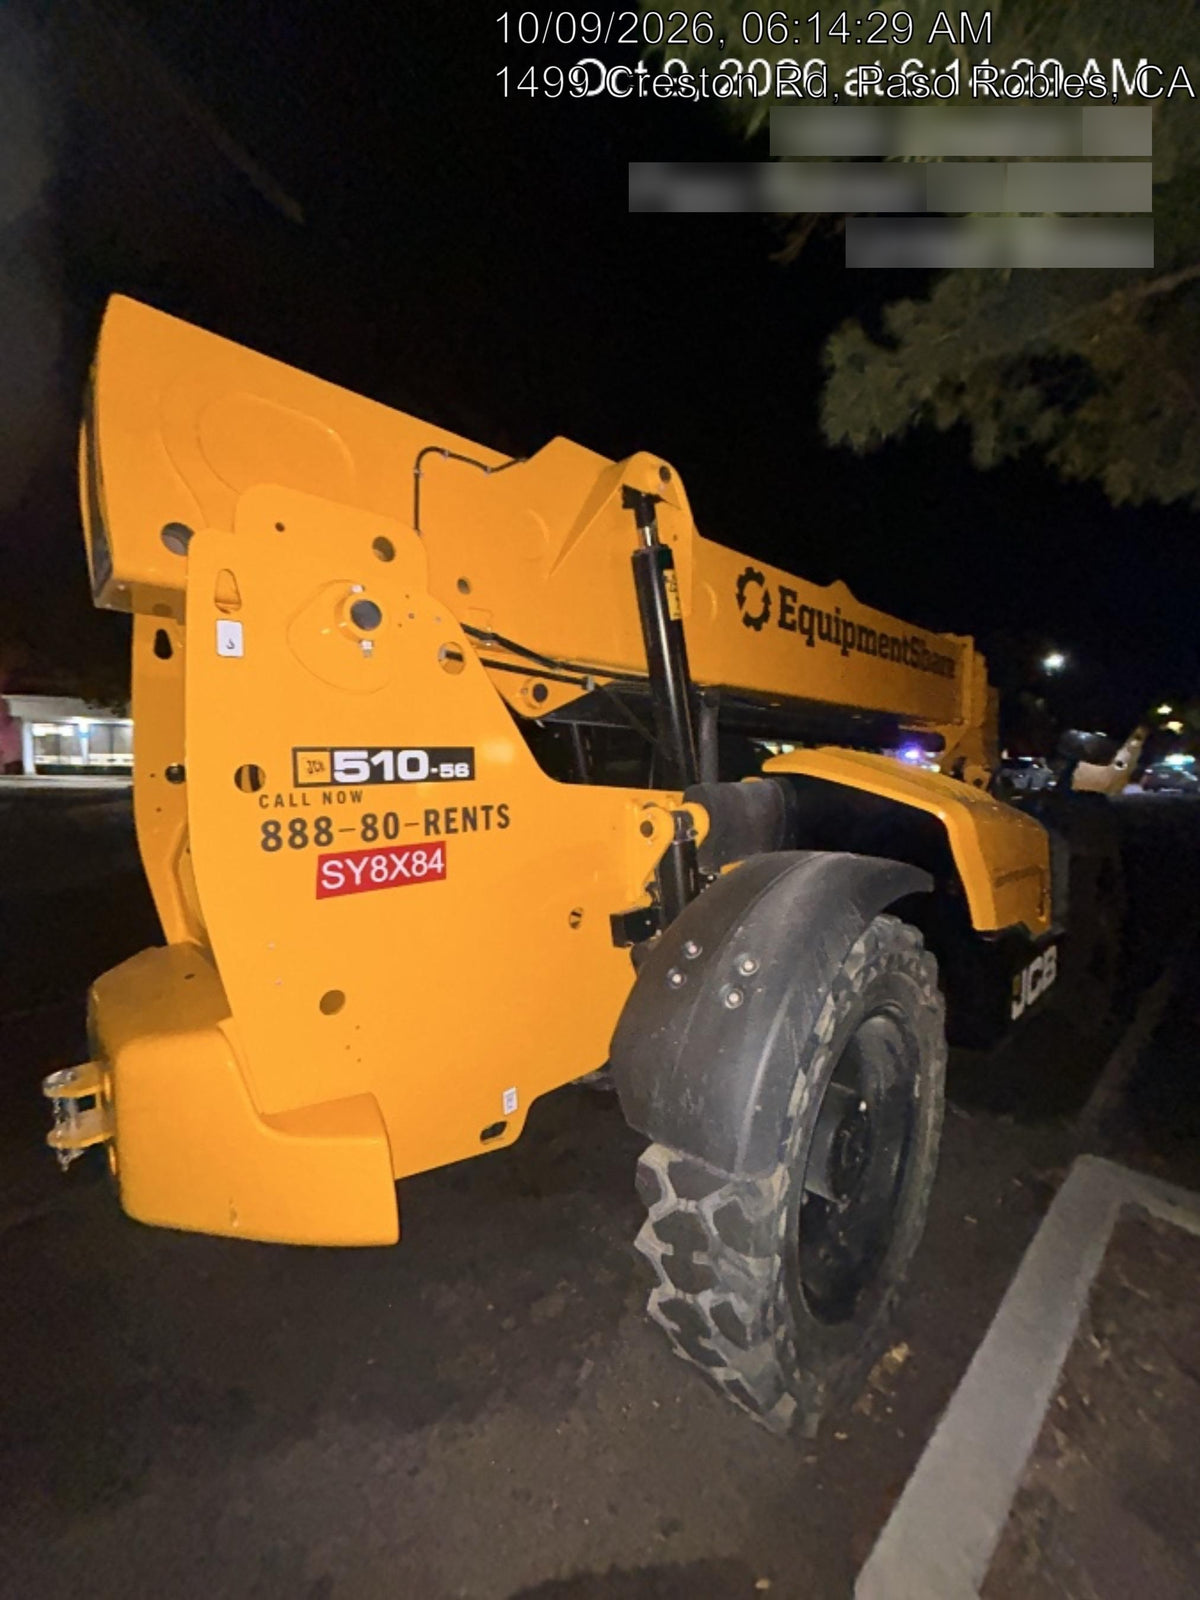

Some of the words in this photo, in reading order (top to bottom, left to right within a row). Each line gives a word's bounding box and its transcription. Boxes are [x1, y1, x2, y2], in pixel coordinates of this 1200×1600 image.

[258, 792, 311, 809] CALL
[322, 789, 364, 805] NOW
[260, 803, 511, 853] 888-80-RENTS
[321, 847, 445, 890] SY8X84
[1011, 944, 1058, 1020] JCB
